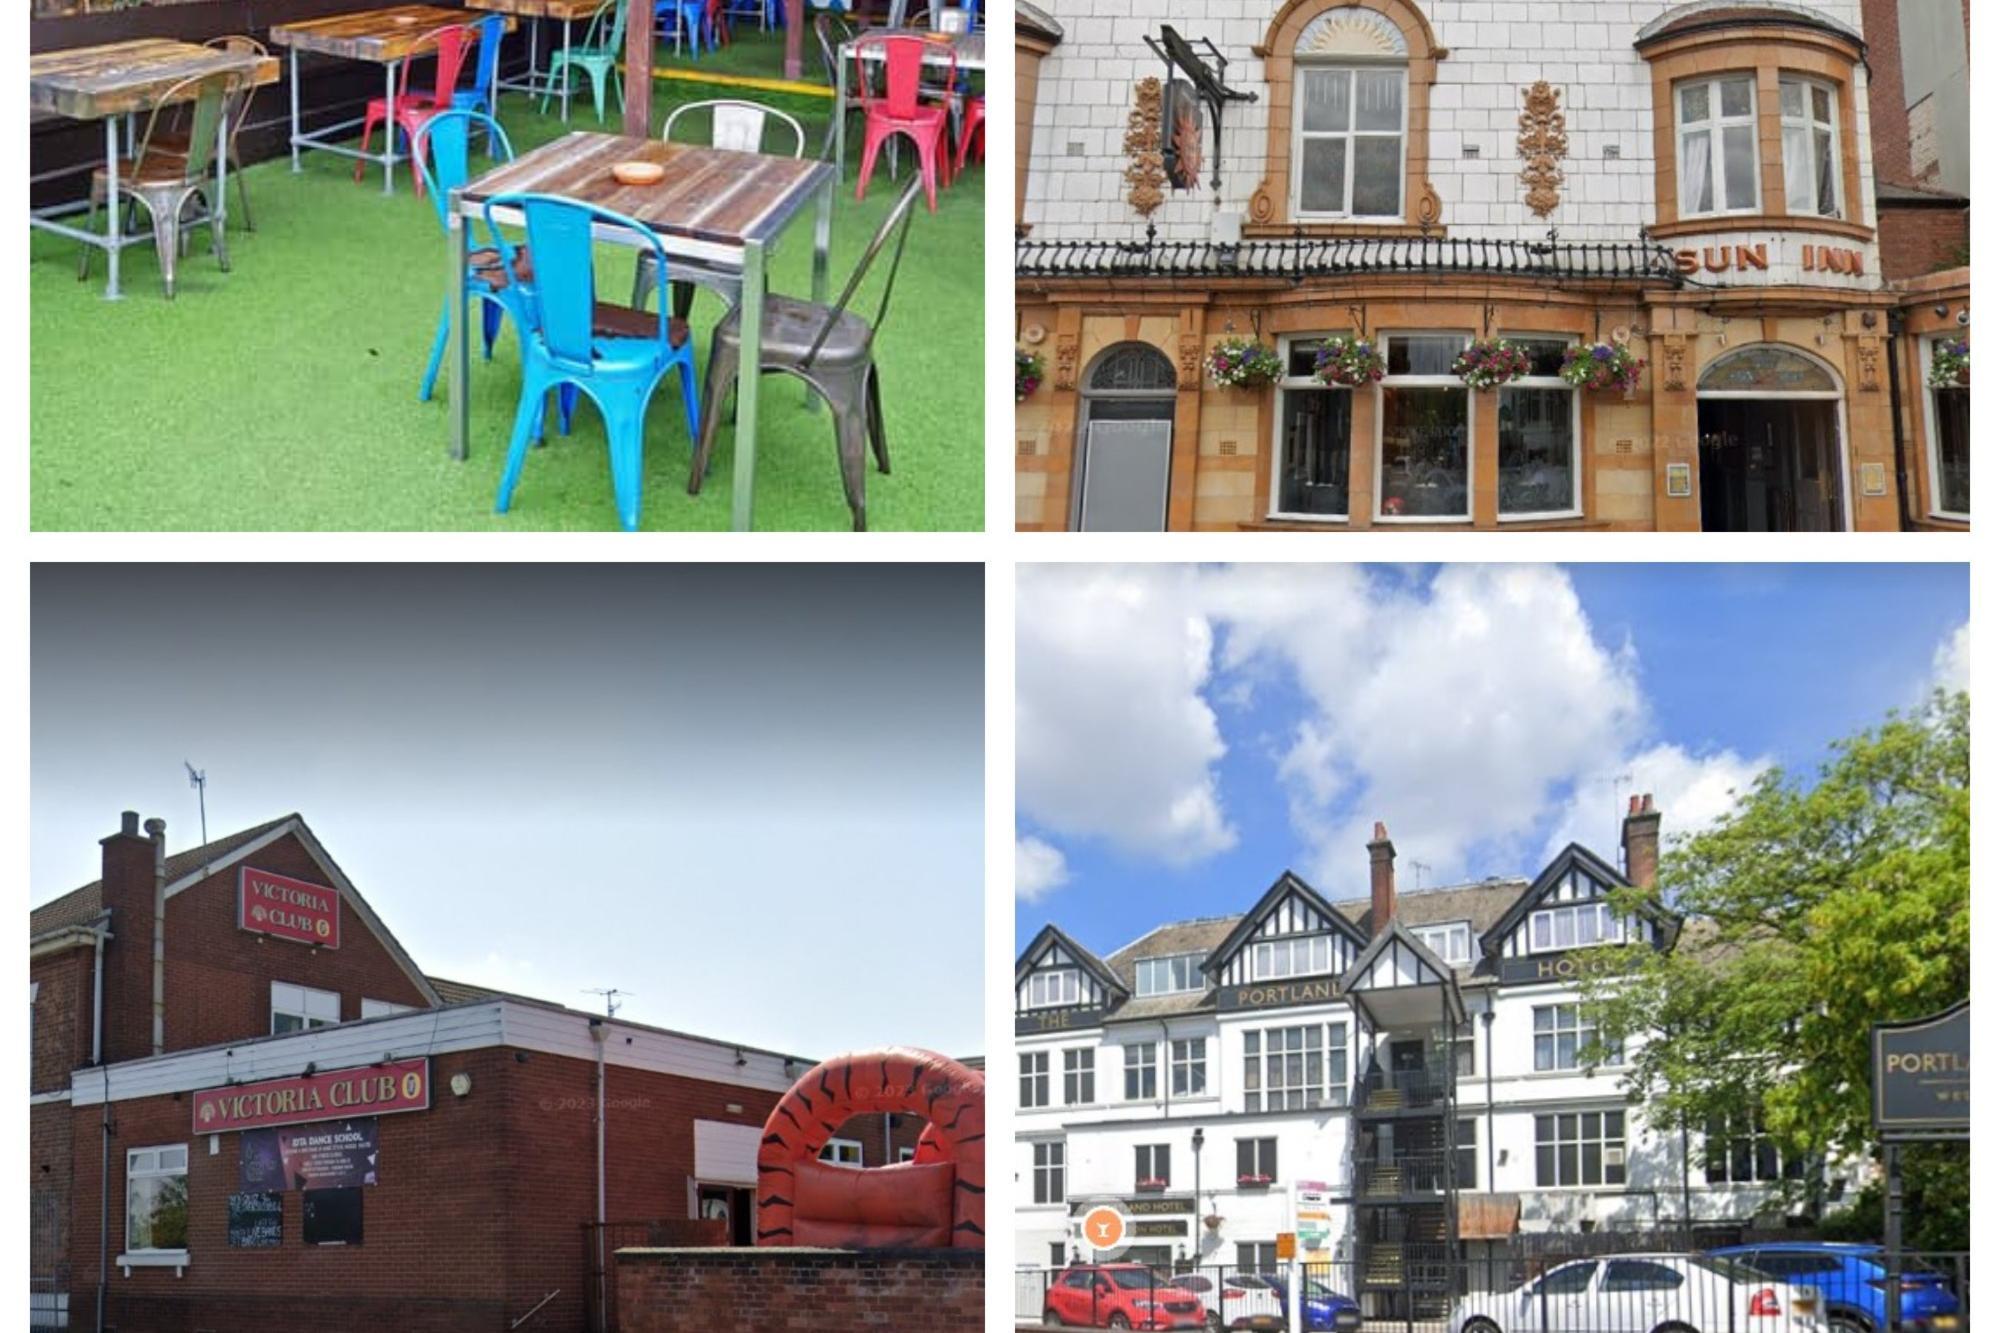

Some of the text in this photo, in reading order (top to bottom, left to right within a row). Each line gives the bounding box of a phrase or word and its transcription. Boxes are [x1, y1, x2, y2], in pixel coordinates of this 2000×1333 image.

[1674, 243, 1864, 278] SUN INN
[252, 879, 330, 912] VICTORIA
[268, 908, 313, 932] CLUB
[1038, 1013, 1071, 1030] THE
[217, 1075, 397, 1121] VICTORIA CLUB
